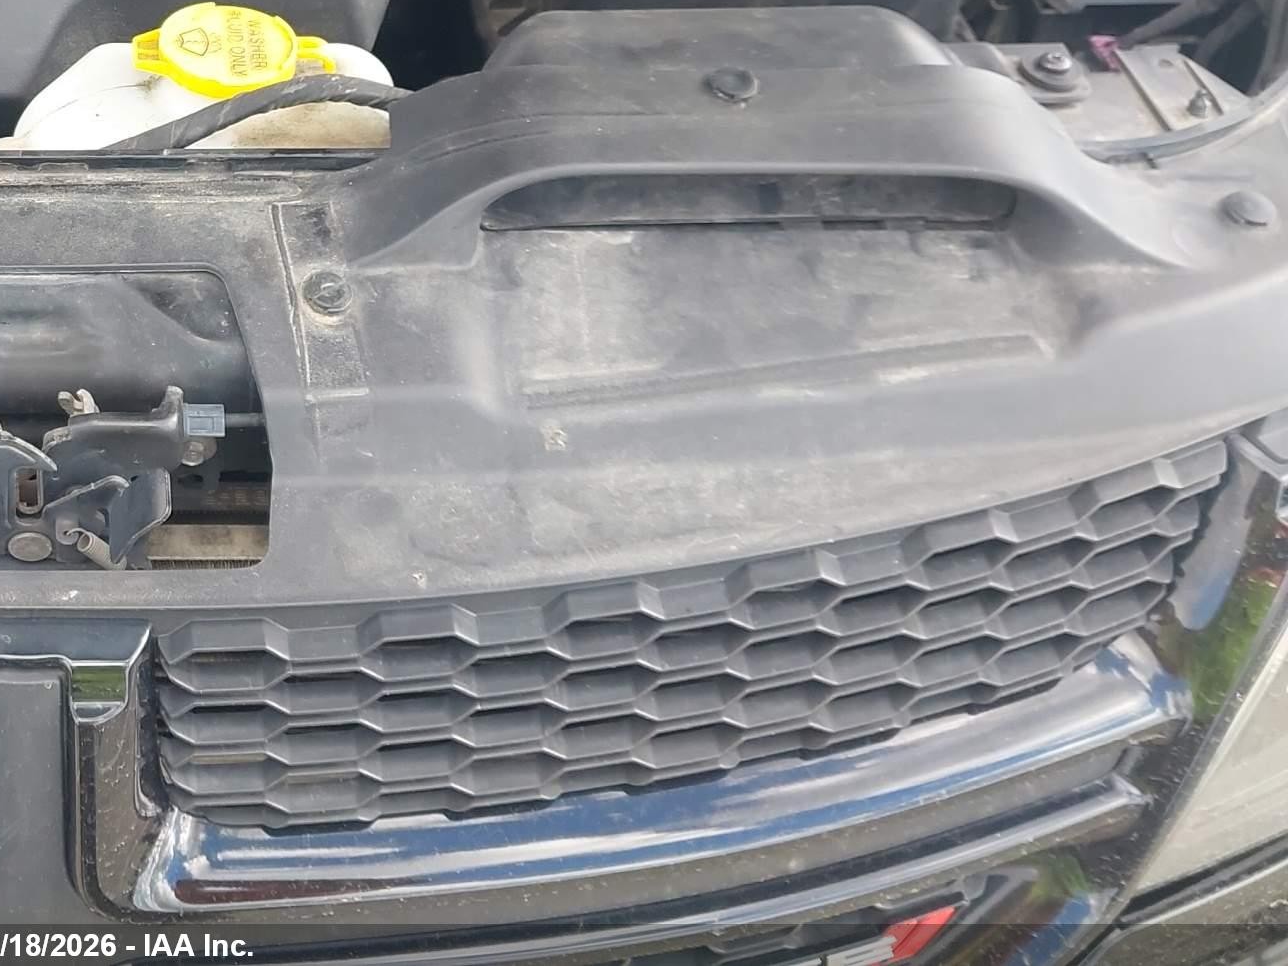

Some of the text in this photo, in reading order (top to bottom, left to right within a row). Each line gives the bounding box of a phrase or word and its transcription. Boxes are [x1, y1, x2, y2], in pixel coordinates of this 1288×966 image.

[226, 10, 248, 78] FLUID ONLY
[247, 19, 269, 71] WASHER
